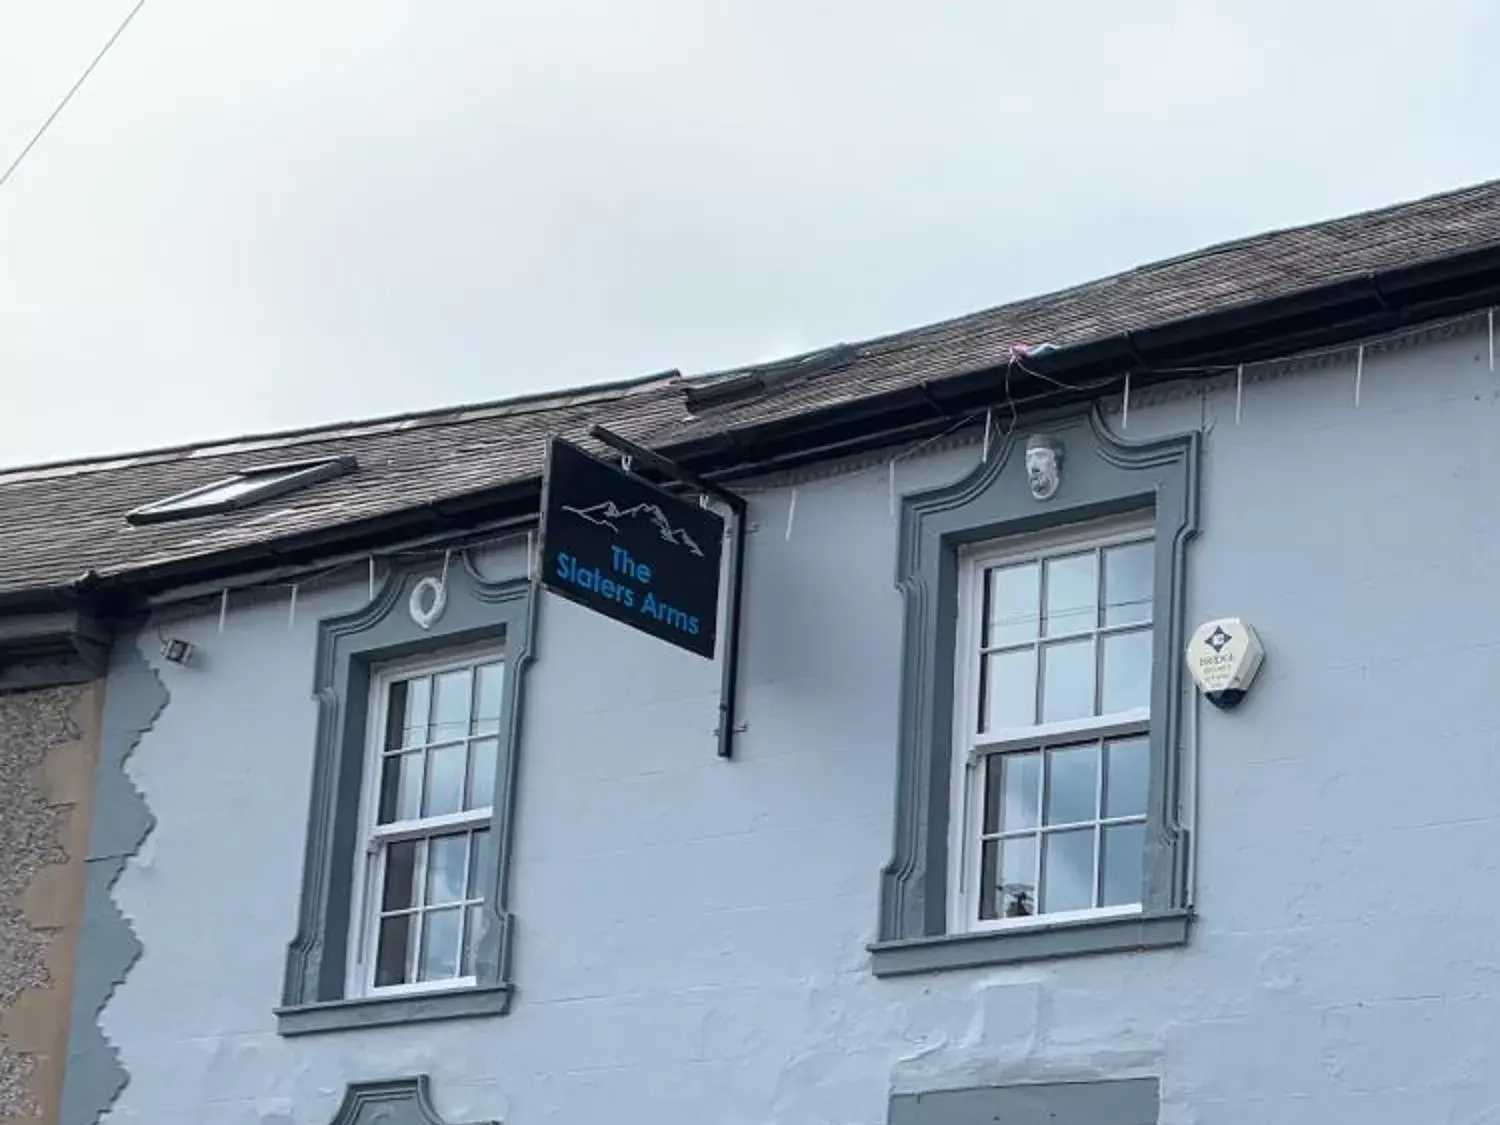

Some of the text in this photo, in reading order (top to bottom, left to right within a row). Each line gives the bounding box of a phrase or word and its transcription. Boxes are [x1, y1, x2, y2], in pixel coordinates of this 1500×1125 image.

[556, 552, 699, 634] Slaters Arms
[611, 545, 651, 583] The
